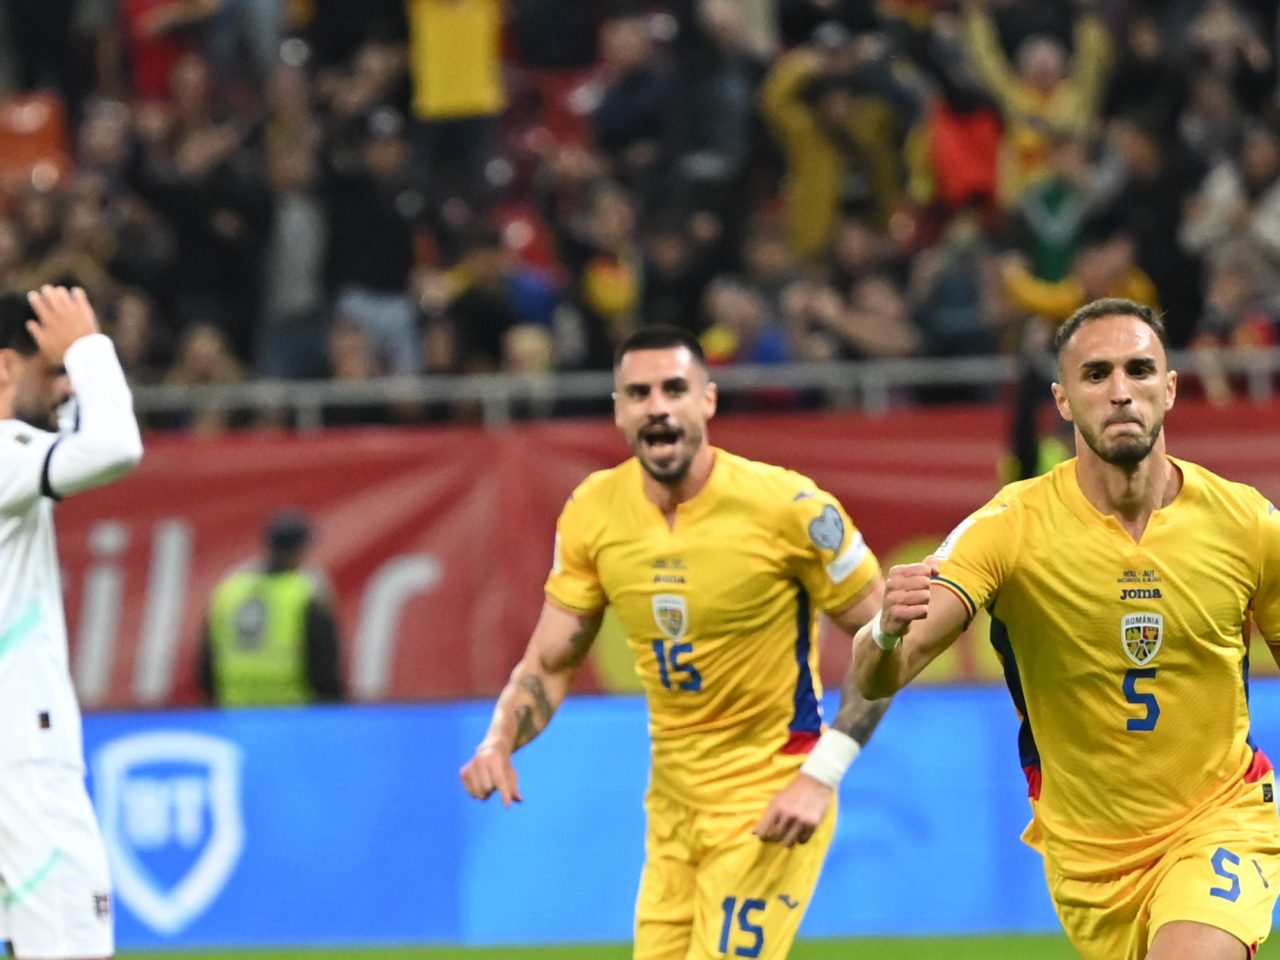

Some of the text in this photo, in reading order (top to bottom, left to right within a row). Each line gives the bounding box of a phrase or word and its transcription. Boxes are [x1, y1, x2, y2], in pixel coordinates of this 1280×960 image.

[652, 639, 703, 692] 15
[1122, 667, 1161, 732] 5
[1209, 846, 1241, 903] 5
[718, 895, 768, 960] 15
